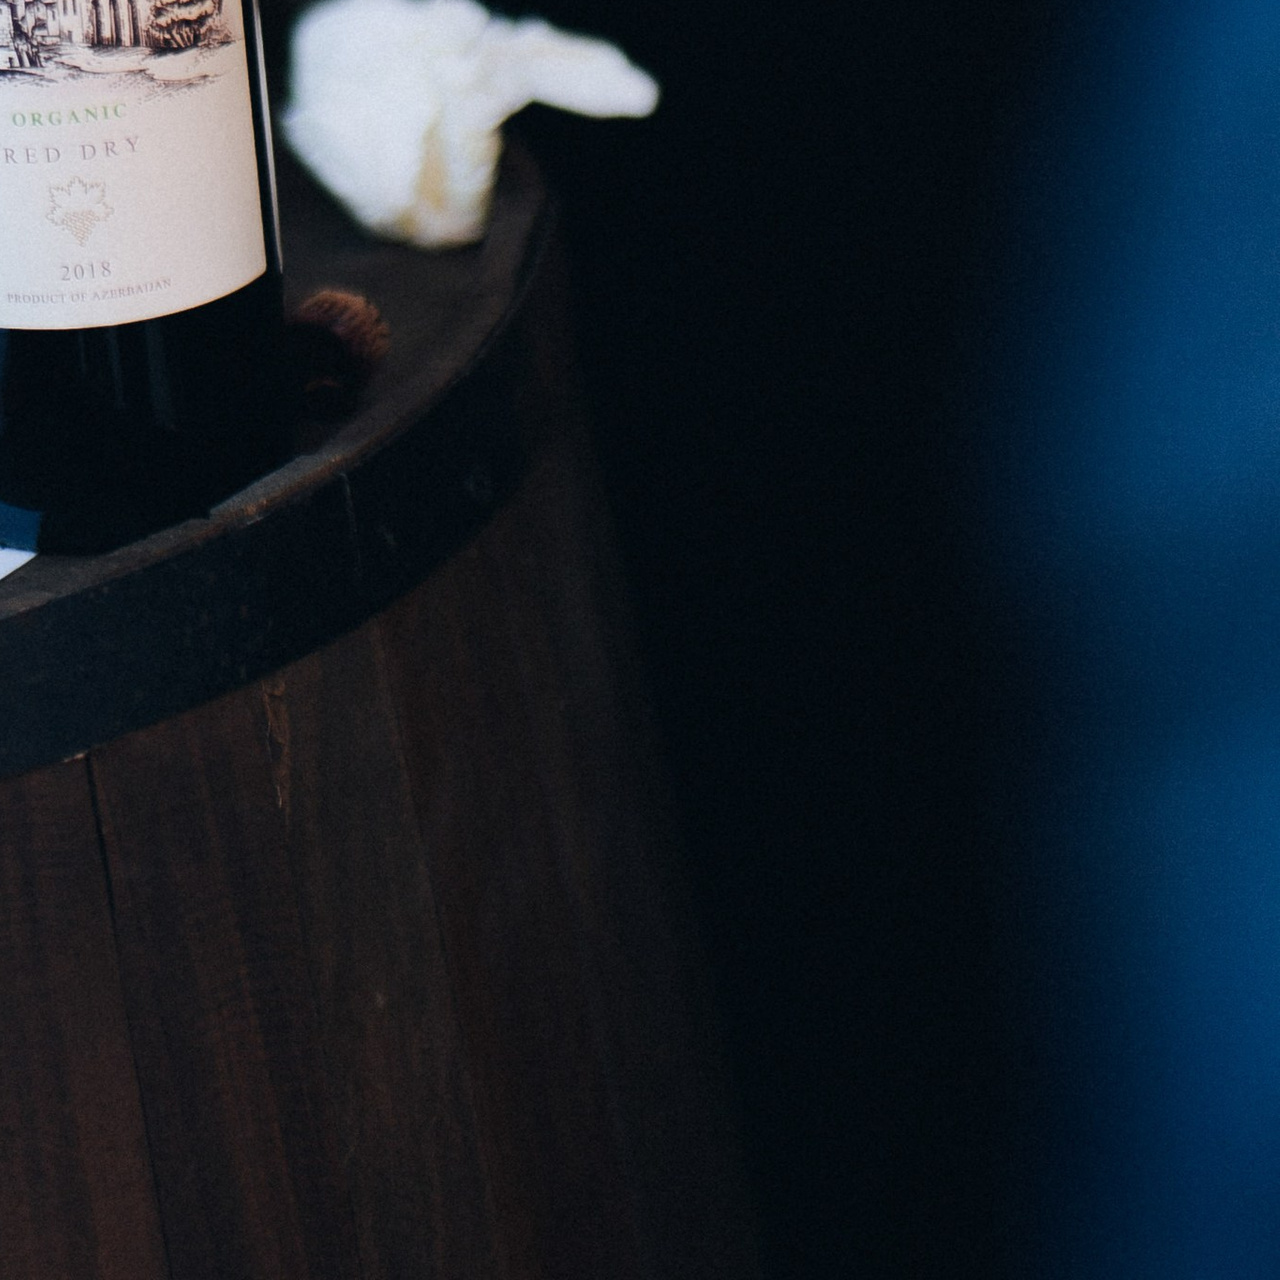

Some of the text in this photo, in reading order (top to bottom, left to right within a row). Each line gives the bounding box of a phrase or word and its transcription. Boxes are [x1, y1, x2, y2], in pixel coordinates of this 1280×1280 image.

[11, 103, 127, 128] ORGANIC
[3, 135, 139, 164] RED DRY
[61, 261, 112, 281] 2018
[7, 292, 66, 305] PRODUCT
[70, 291, 87, 304] OF
